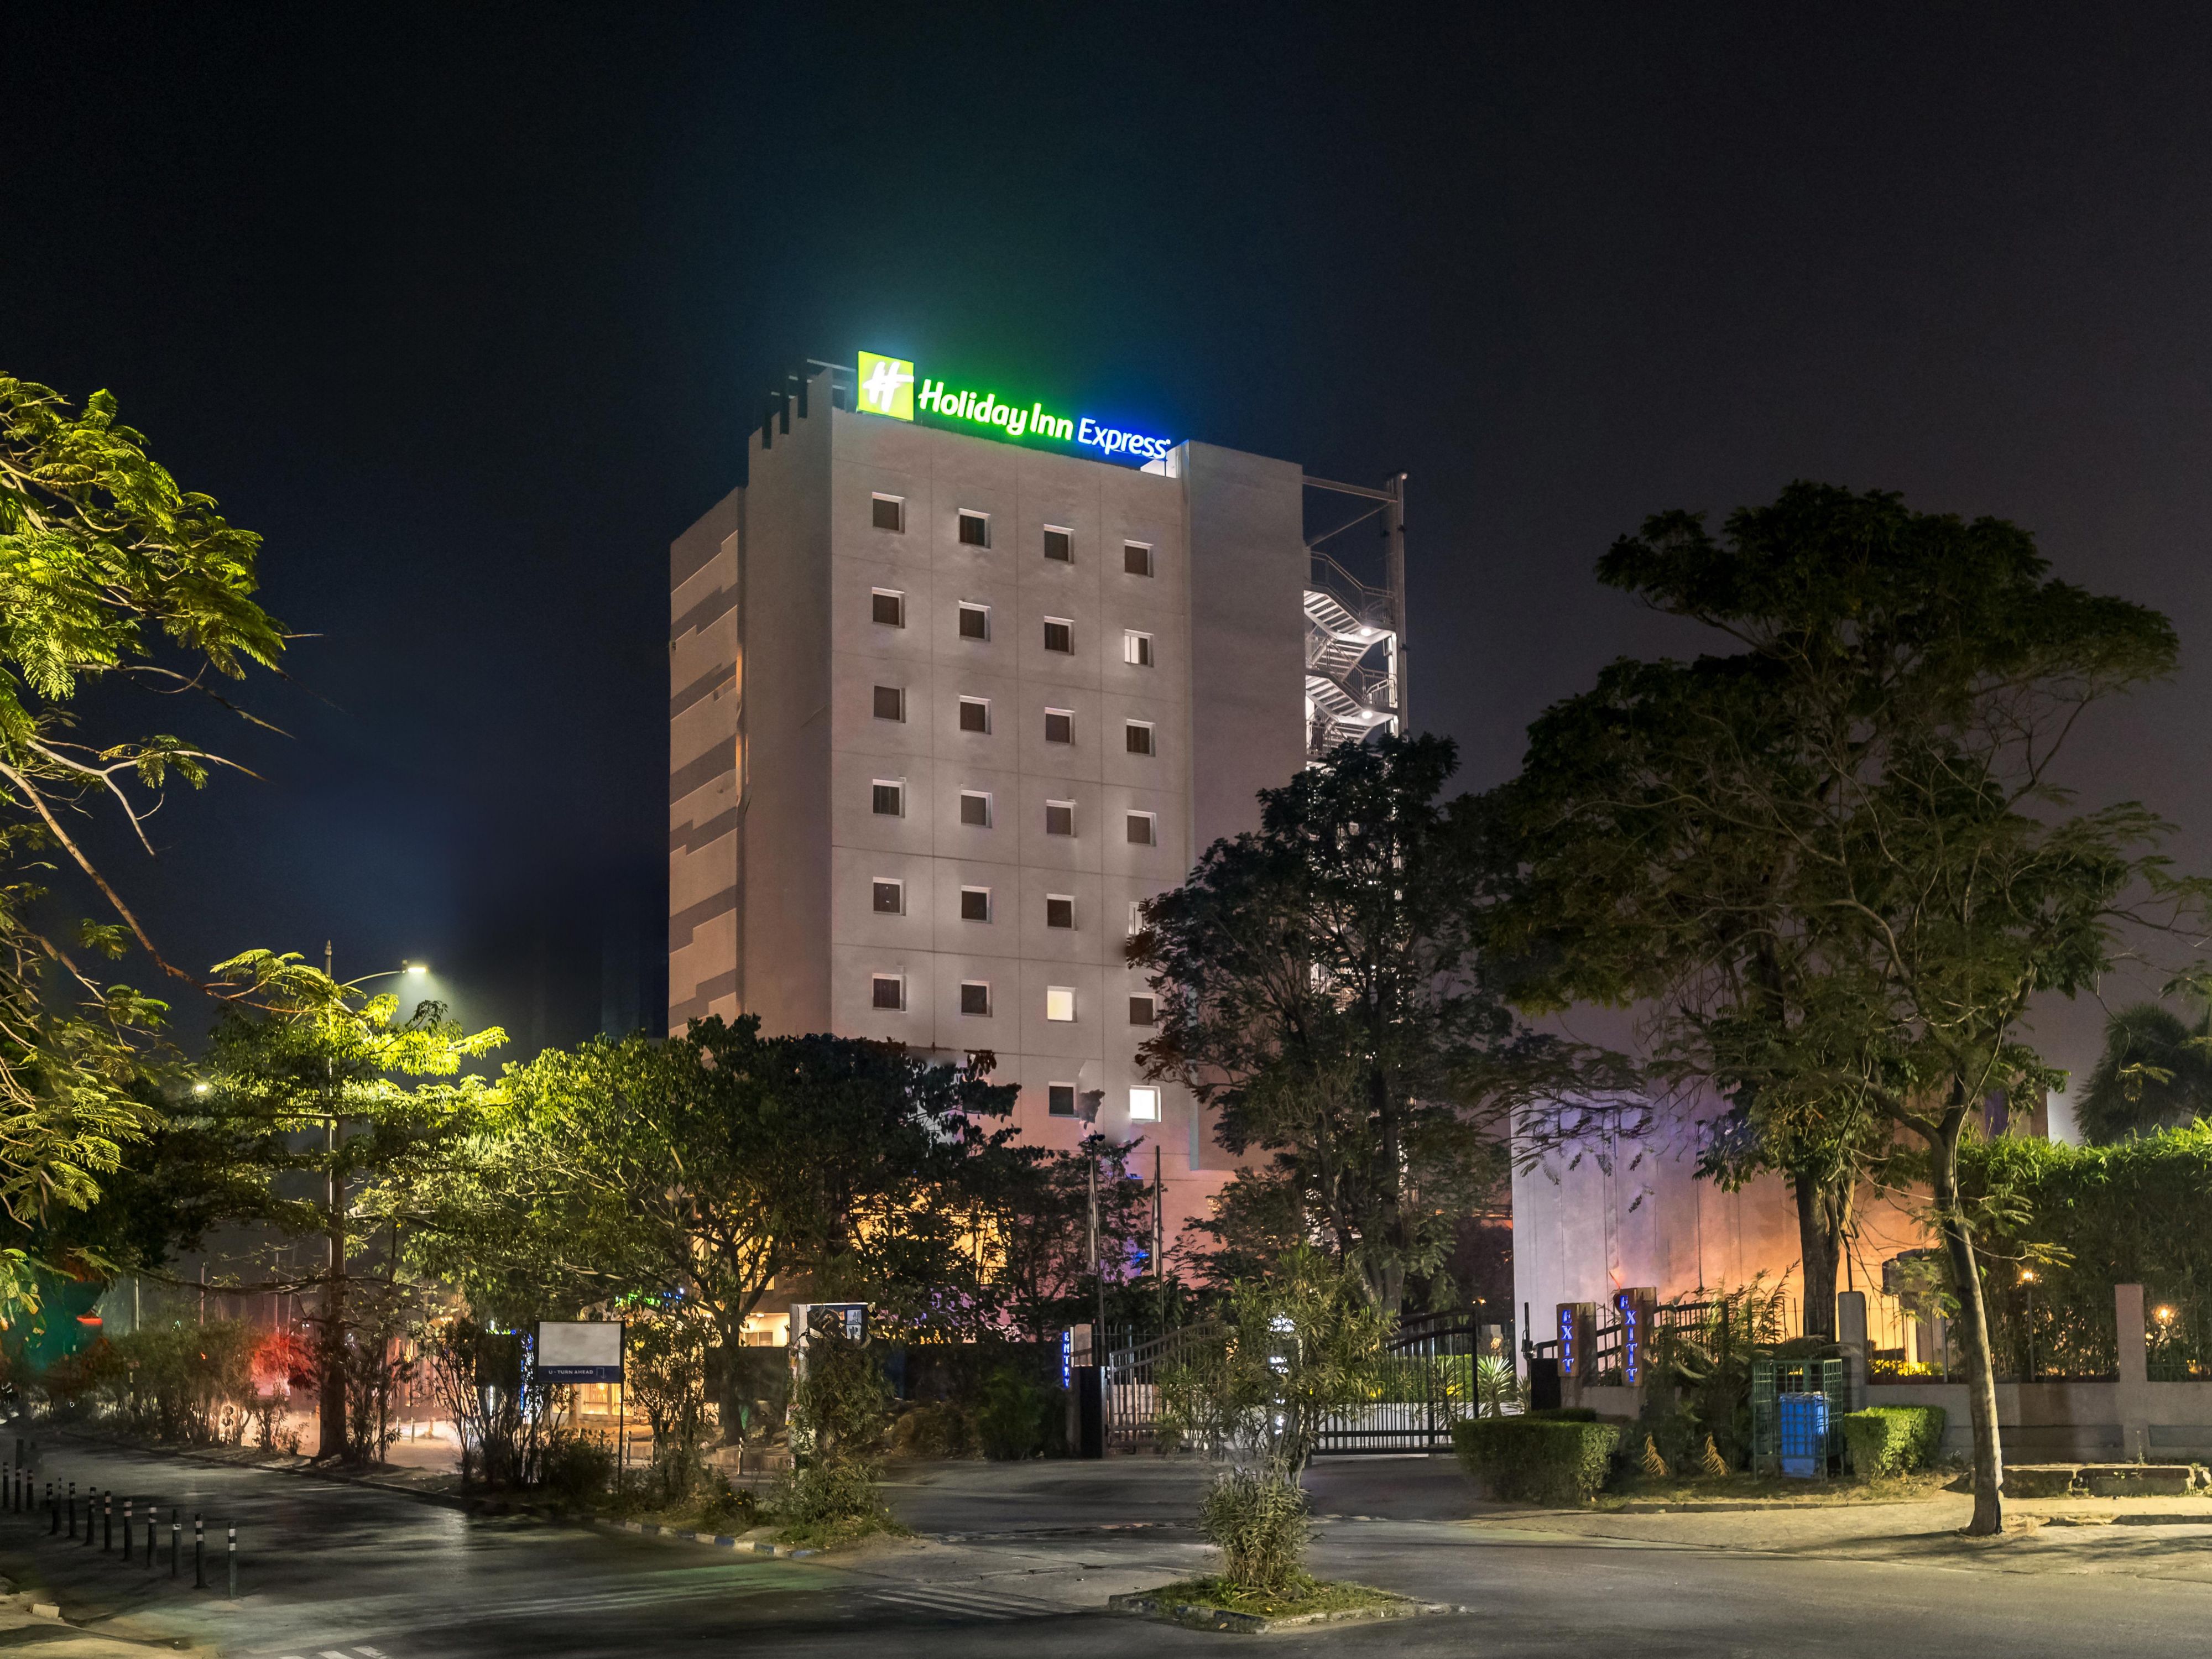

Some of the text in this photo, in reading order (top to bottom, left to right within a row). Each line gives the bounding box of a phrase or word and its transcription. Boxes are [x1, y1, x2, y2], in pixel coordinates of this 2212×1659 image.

[918, 379, 1167, 459] Holiday Inn Express
[1561, 1309, 1574, 1373] EXIT
